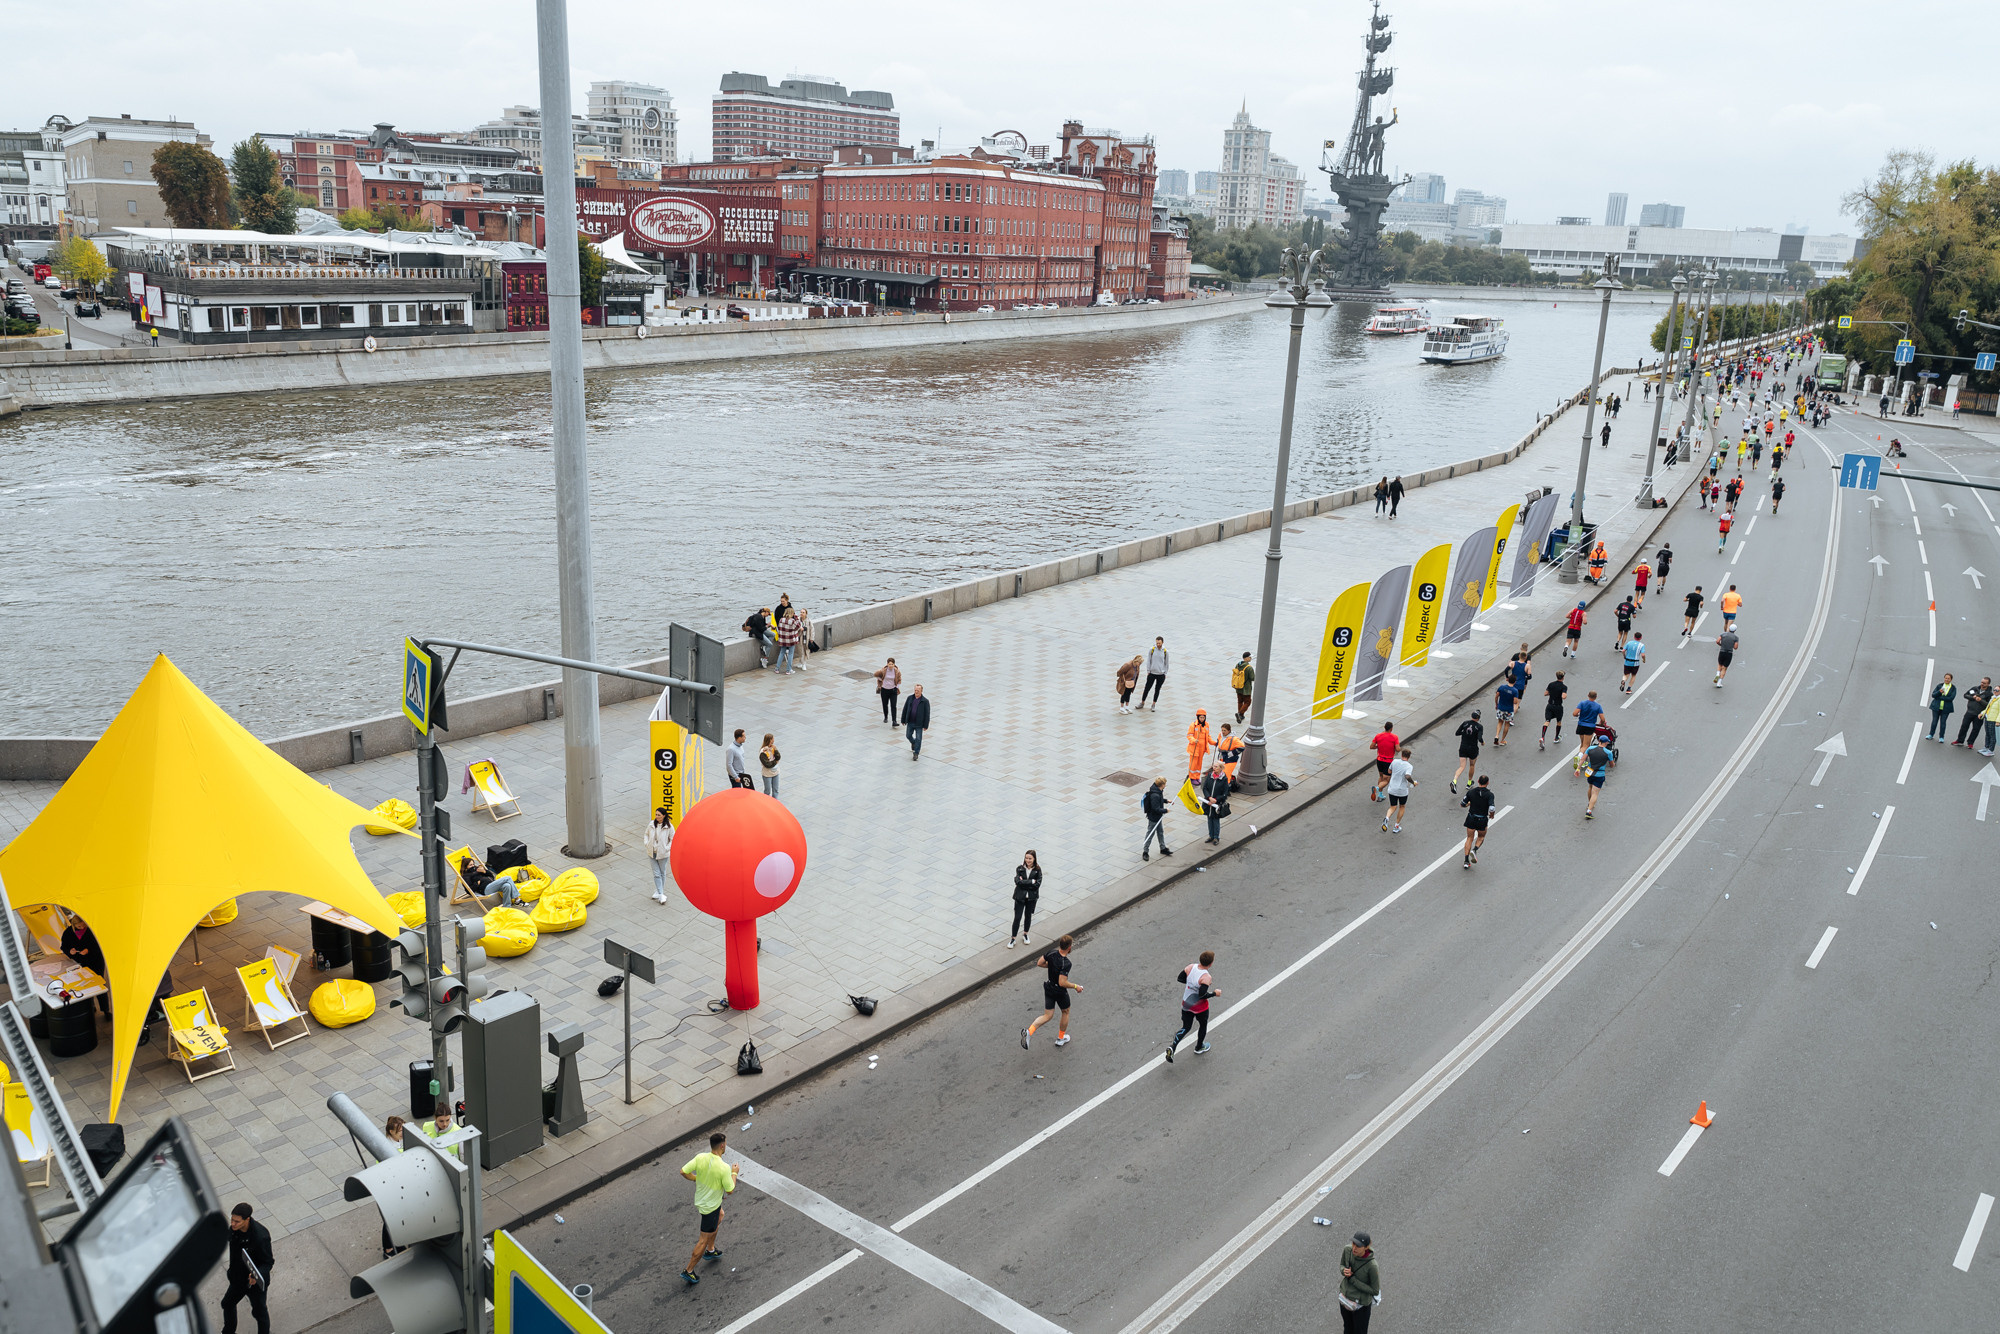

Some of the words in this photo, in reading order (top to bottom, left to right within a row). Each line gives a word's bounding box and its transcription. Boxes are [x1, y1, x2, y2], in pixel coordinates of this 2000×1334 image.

[583, 201, 627, 216] ЭЙНЕМЪ
[642, 208, 694, 227] Красный
[724, 219, 774, 232] ТРАДИЦИИ
[658, 221, 703, 241] Октябрь
[724, 231, 774, 243] КАЧЕСТВА
[1421, 585, 1434, 600] Go
[1415, 603, 1431, 643] Яндекс
[1335, 629, 1349, 645] Go
[1327, 650, 1346, 693] Яндекс
[659, 751, 673, 769] Go
